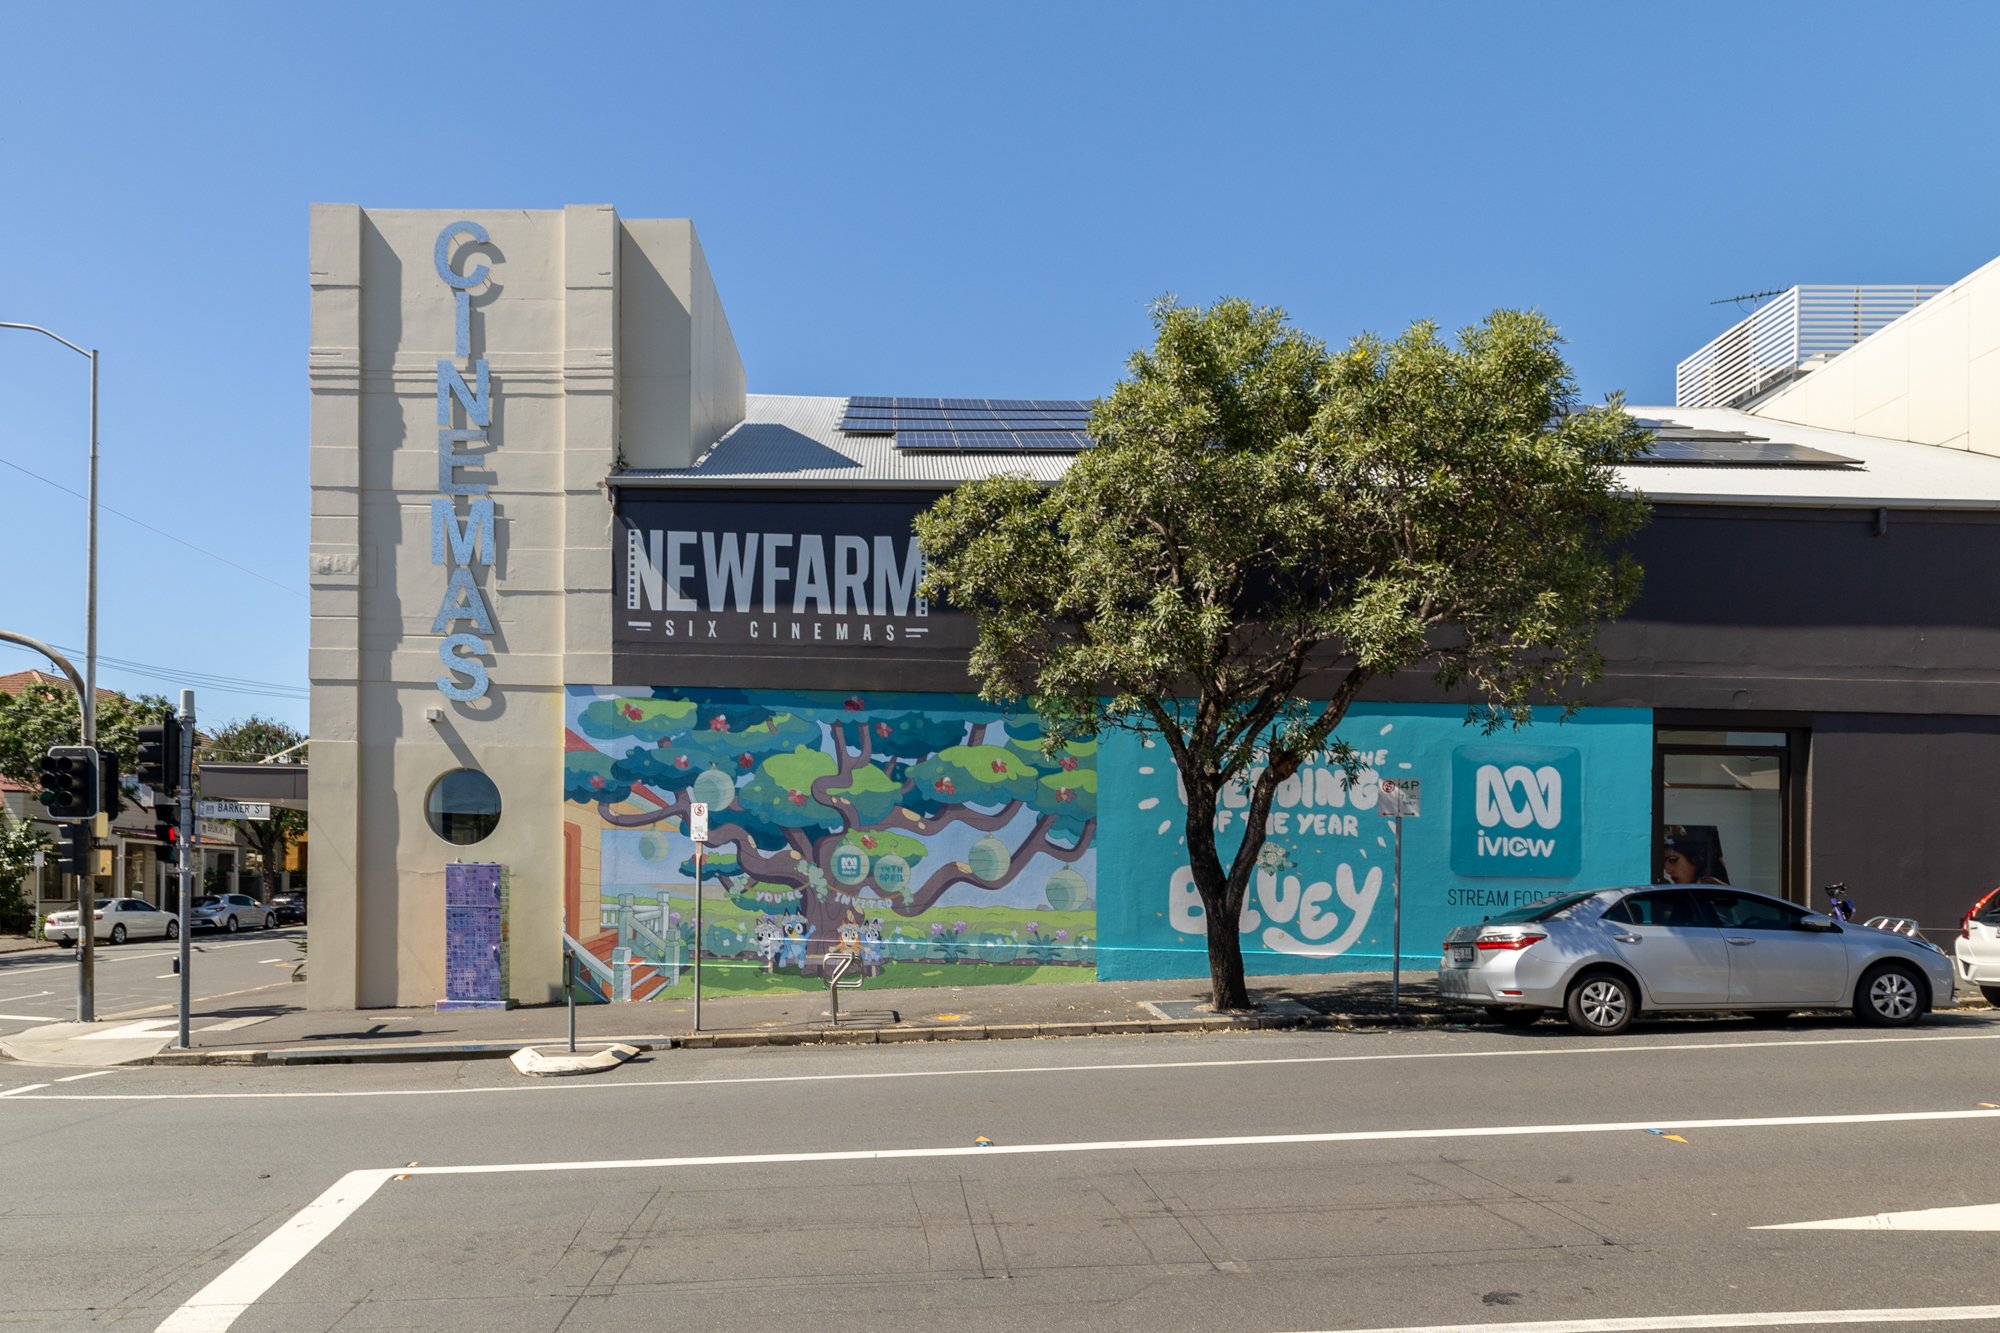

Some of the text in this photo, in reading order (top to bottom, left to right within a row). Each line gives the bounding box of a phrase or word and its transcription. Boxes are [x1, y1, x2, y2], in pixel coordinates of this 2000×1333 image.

[431, 220, 496, 702] CINEMAS
[628, 529, 928, 617] NEWFARM
[665, 620, 895, 641] SIX CINEMAS
[1401, 780, 1420, 790] 4P
[217, 803, 250, 815] BARKER
[254, 804, 264, 815] ST
[1297, 813, 1359, 838] YEAR
[1477, 829, 1556, 858] iview
[879, 873, 905, 883] APRIL
[834, 892, 893, 910] INVITED
[1447, 889, 1508, 907] STREAM
